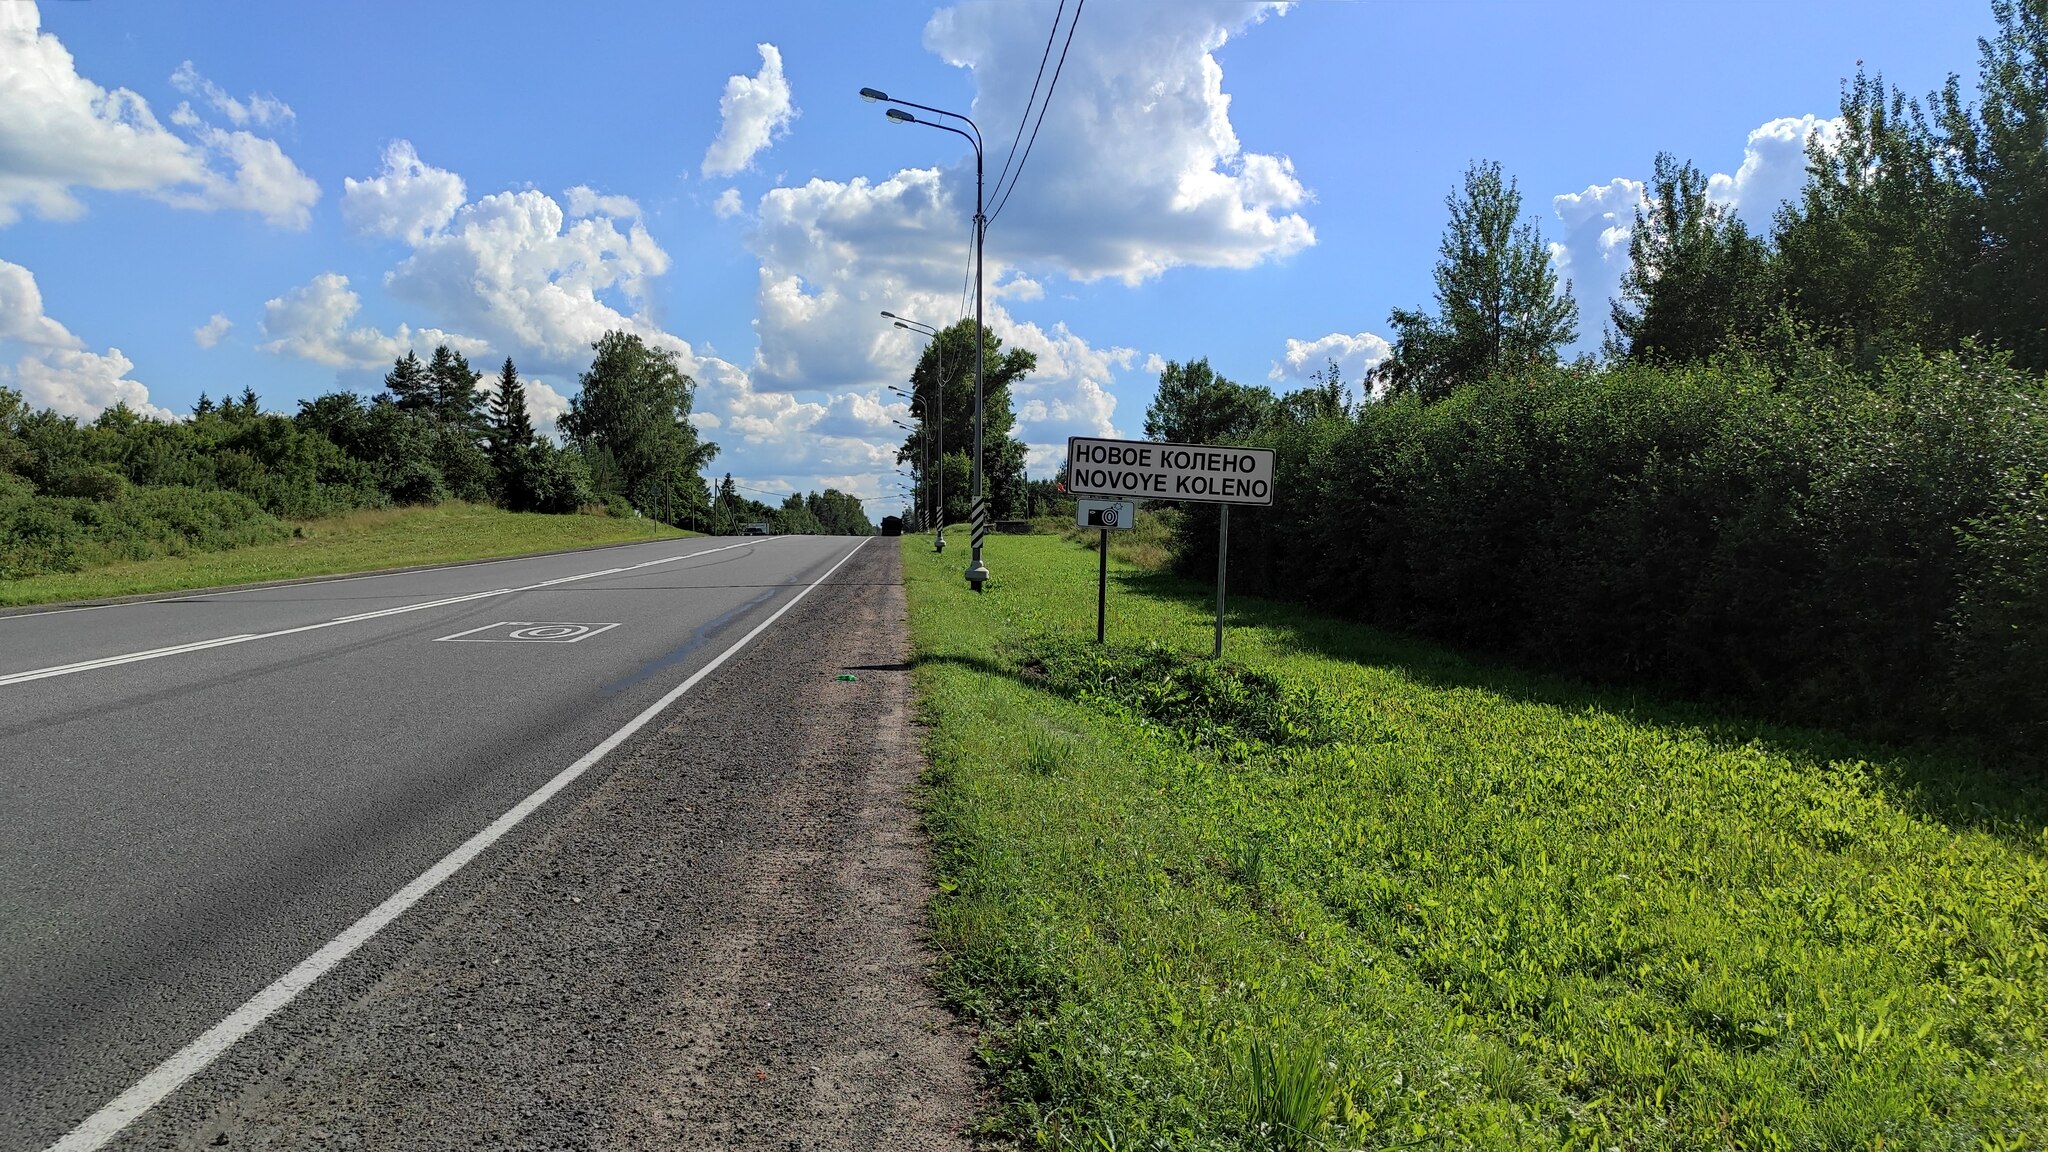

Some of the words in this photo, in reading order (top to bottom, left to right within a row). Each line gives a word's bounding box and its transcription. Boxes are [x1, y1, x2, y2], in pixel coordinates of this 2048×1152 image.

[1076, 444, 1152, 467] НОВОЕ
[1160, 450, 1256, 473] КОЛЕНО
[1075, 469, 1167, 492] NOVOYE
[1176, 475, 1268, 498] KOLENO
